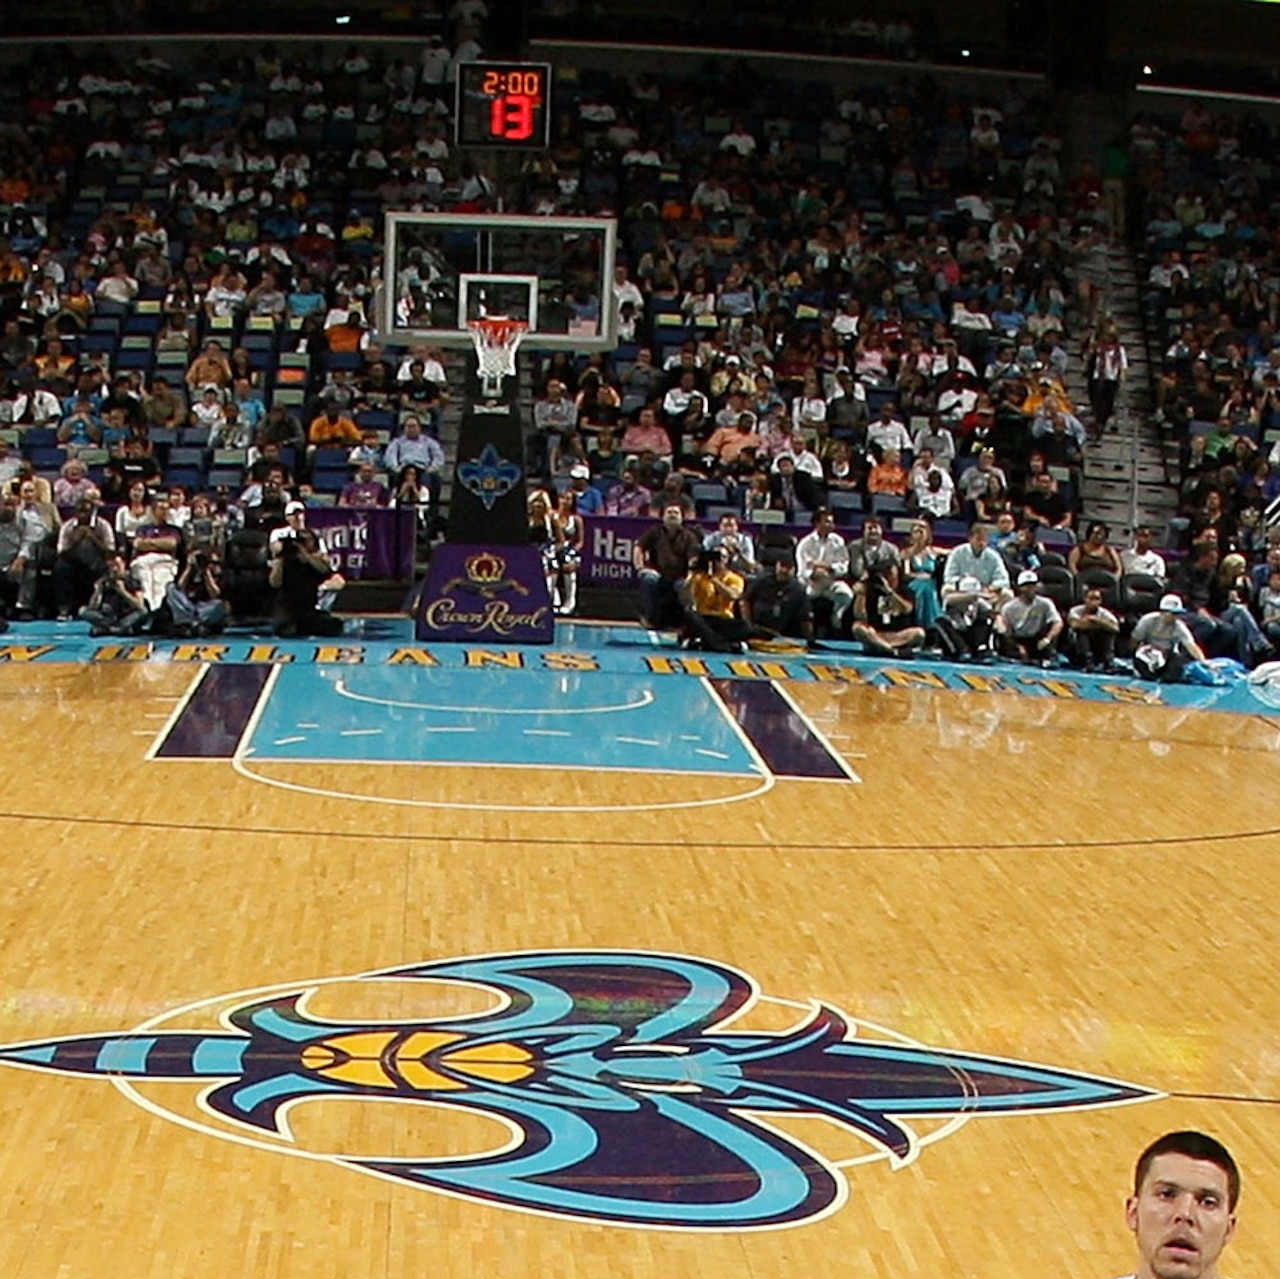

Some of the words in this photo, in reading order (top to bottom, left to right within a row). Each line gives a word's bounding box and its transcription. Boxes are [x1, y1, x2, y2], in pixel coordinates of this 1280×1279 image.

[483, 71, 539, 96] 2:00
[490, 94, 534, 140] 13
[591, 564, 633, 579] HIGH
[425, 599, 485, 630] Crown
[469, 599, 544, 635] Royal
[95, 643, 601, 671] ORLEANS
[643, 656, 1166, 704] HORNETS
